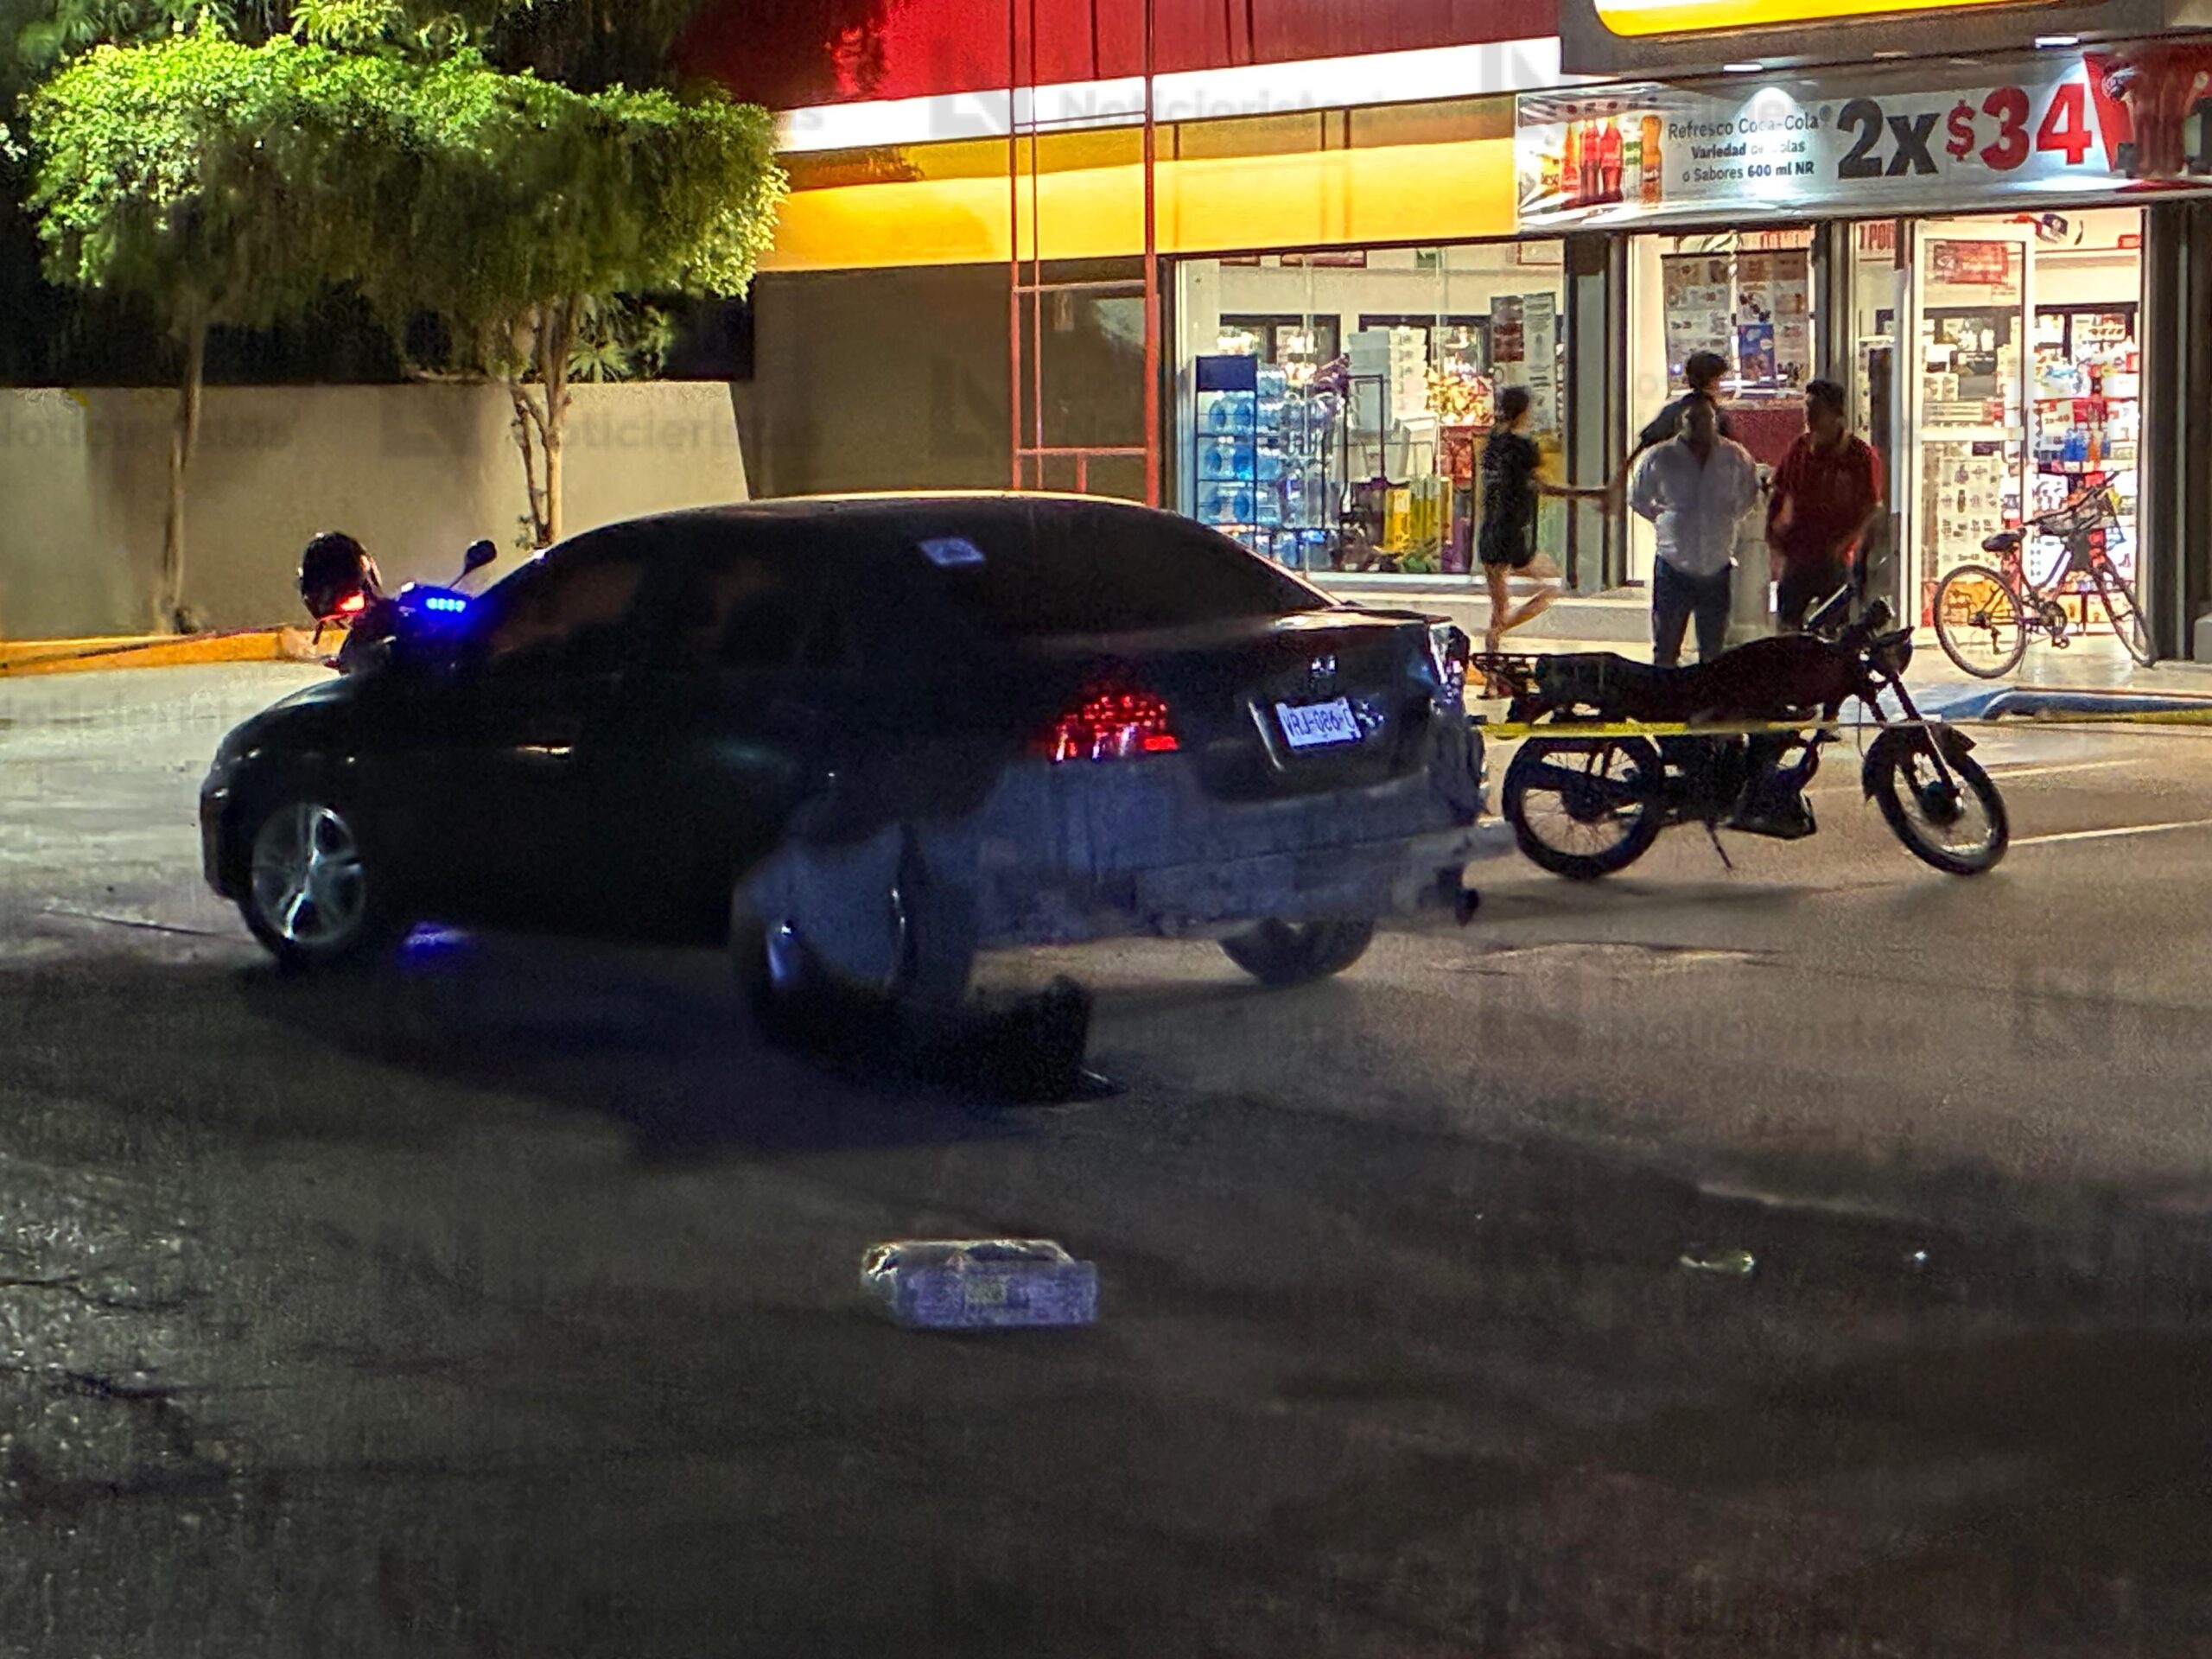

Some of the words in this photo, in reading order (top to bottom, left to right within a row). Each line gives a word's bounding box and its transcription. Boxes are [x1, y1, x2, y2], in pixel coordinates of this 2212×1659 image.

[1668, 119, 1733, 139] Refresco
[1691, 142, 1746, 159] Variedad
[1694, 164, 1744, 181] Sabores
[1747, 163, 1772, 178] 600
[1776, 162, 1792, 176] ml
[1795, 161, 1815, 175] NR
